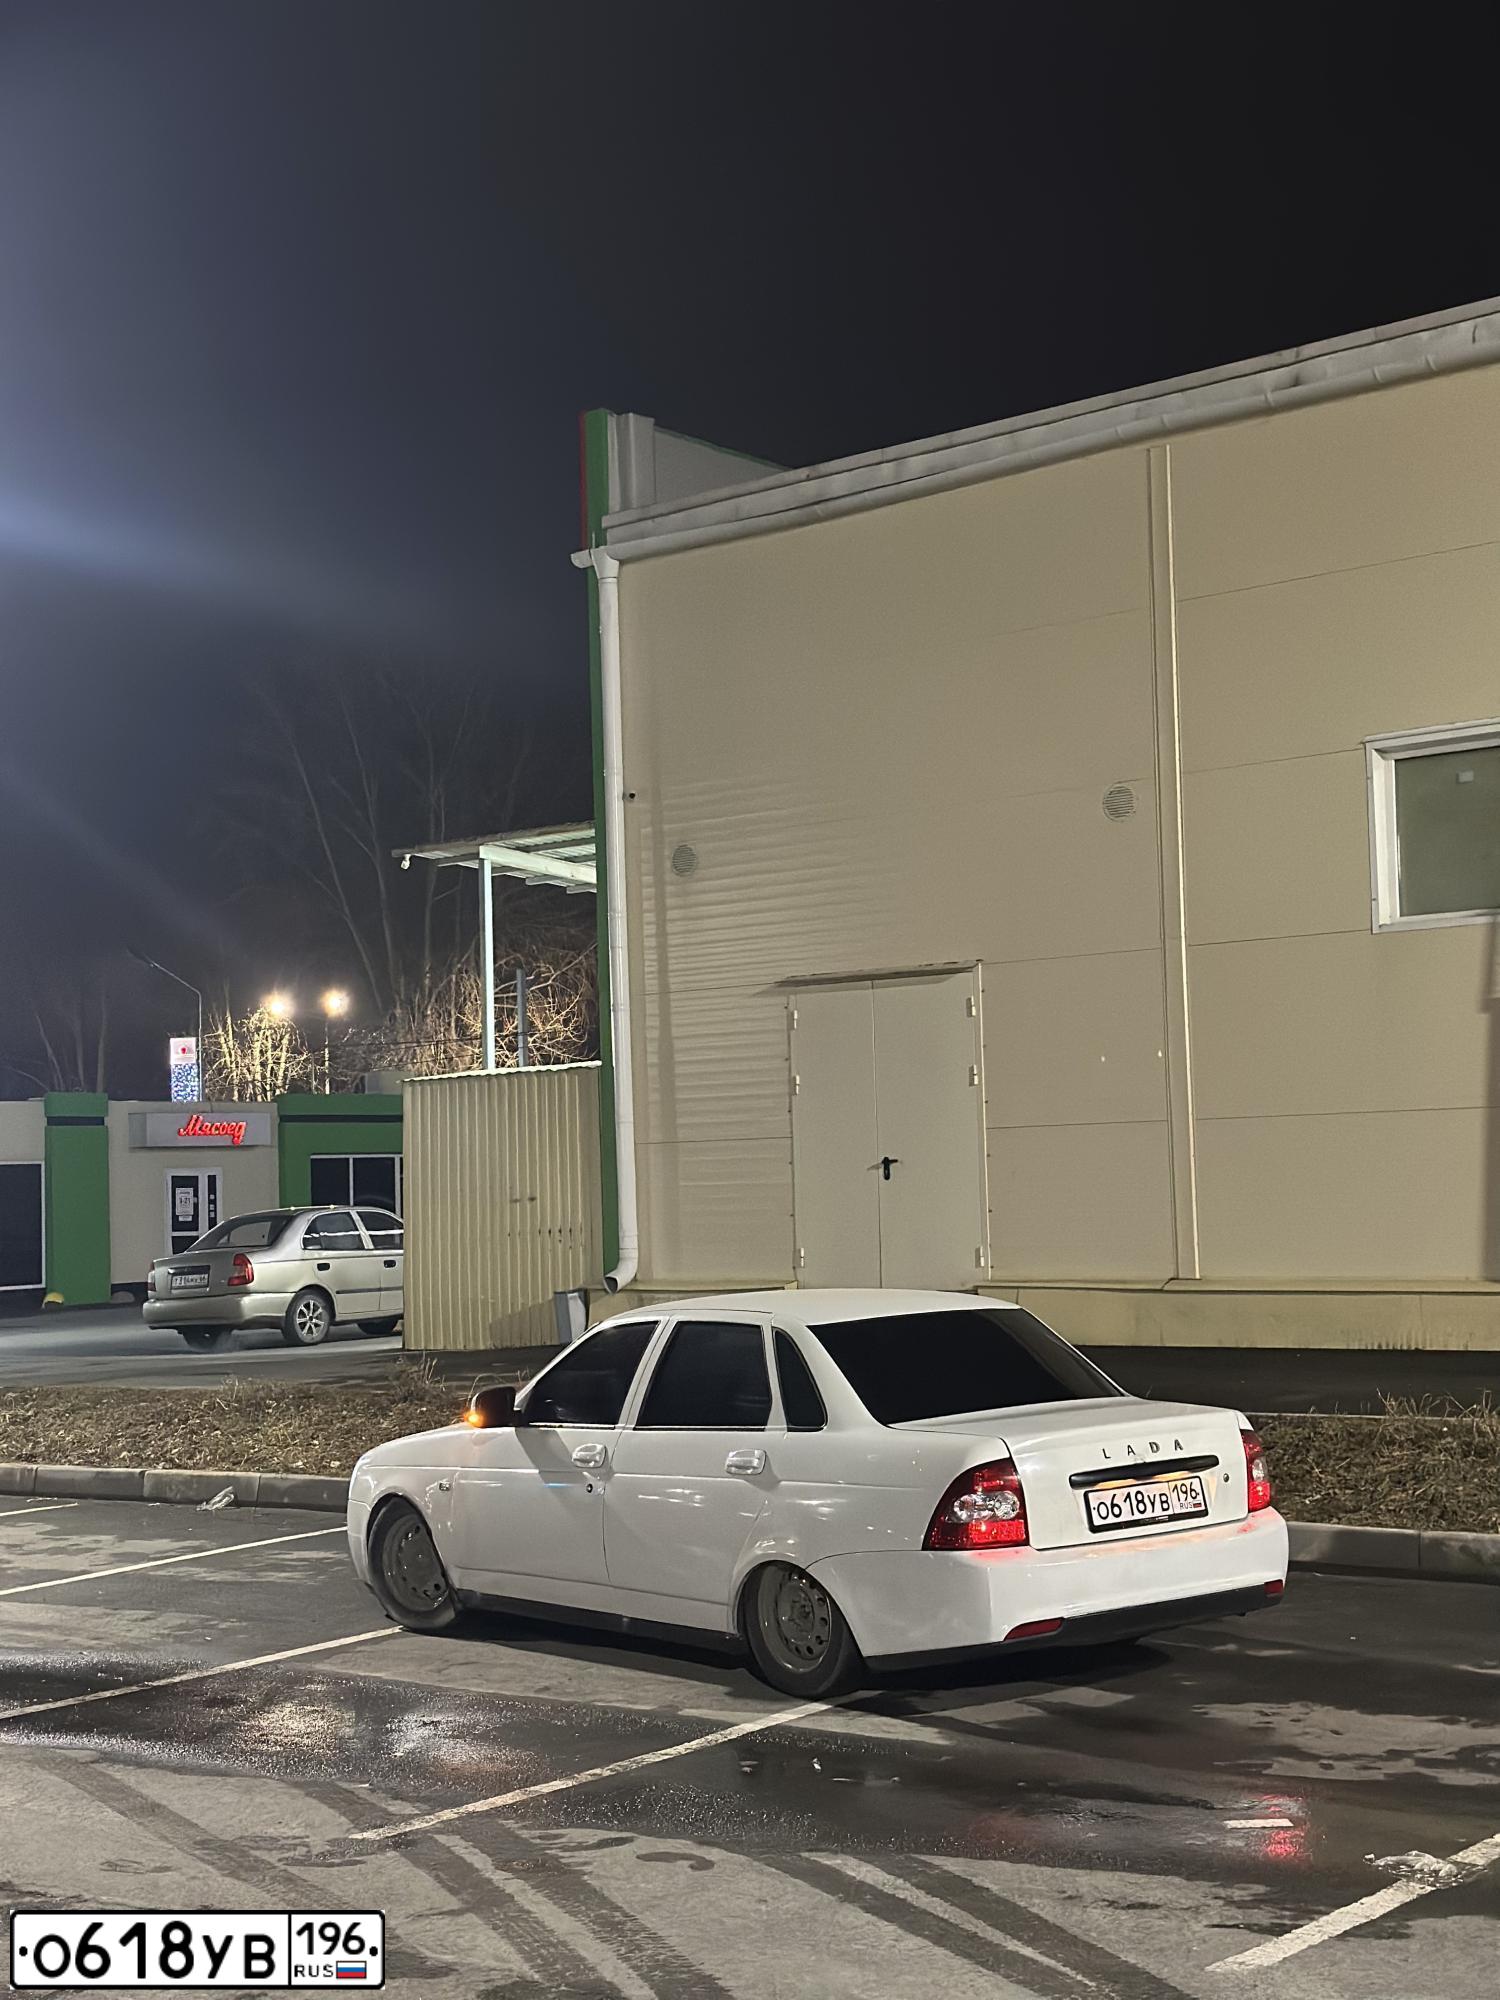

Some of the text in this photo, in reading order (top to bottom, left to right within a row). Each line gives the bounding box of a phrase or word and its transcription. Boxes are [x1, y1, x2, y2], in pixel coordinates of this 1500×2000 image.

[178, 1114, 247, 1145] Мясоед
[1102, 1439, 1183, 1460] LADA
[1172, 1482, 1198, 1503] 196
[1180, 1502, 1193, 1510] RUS
